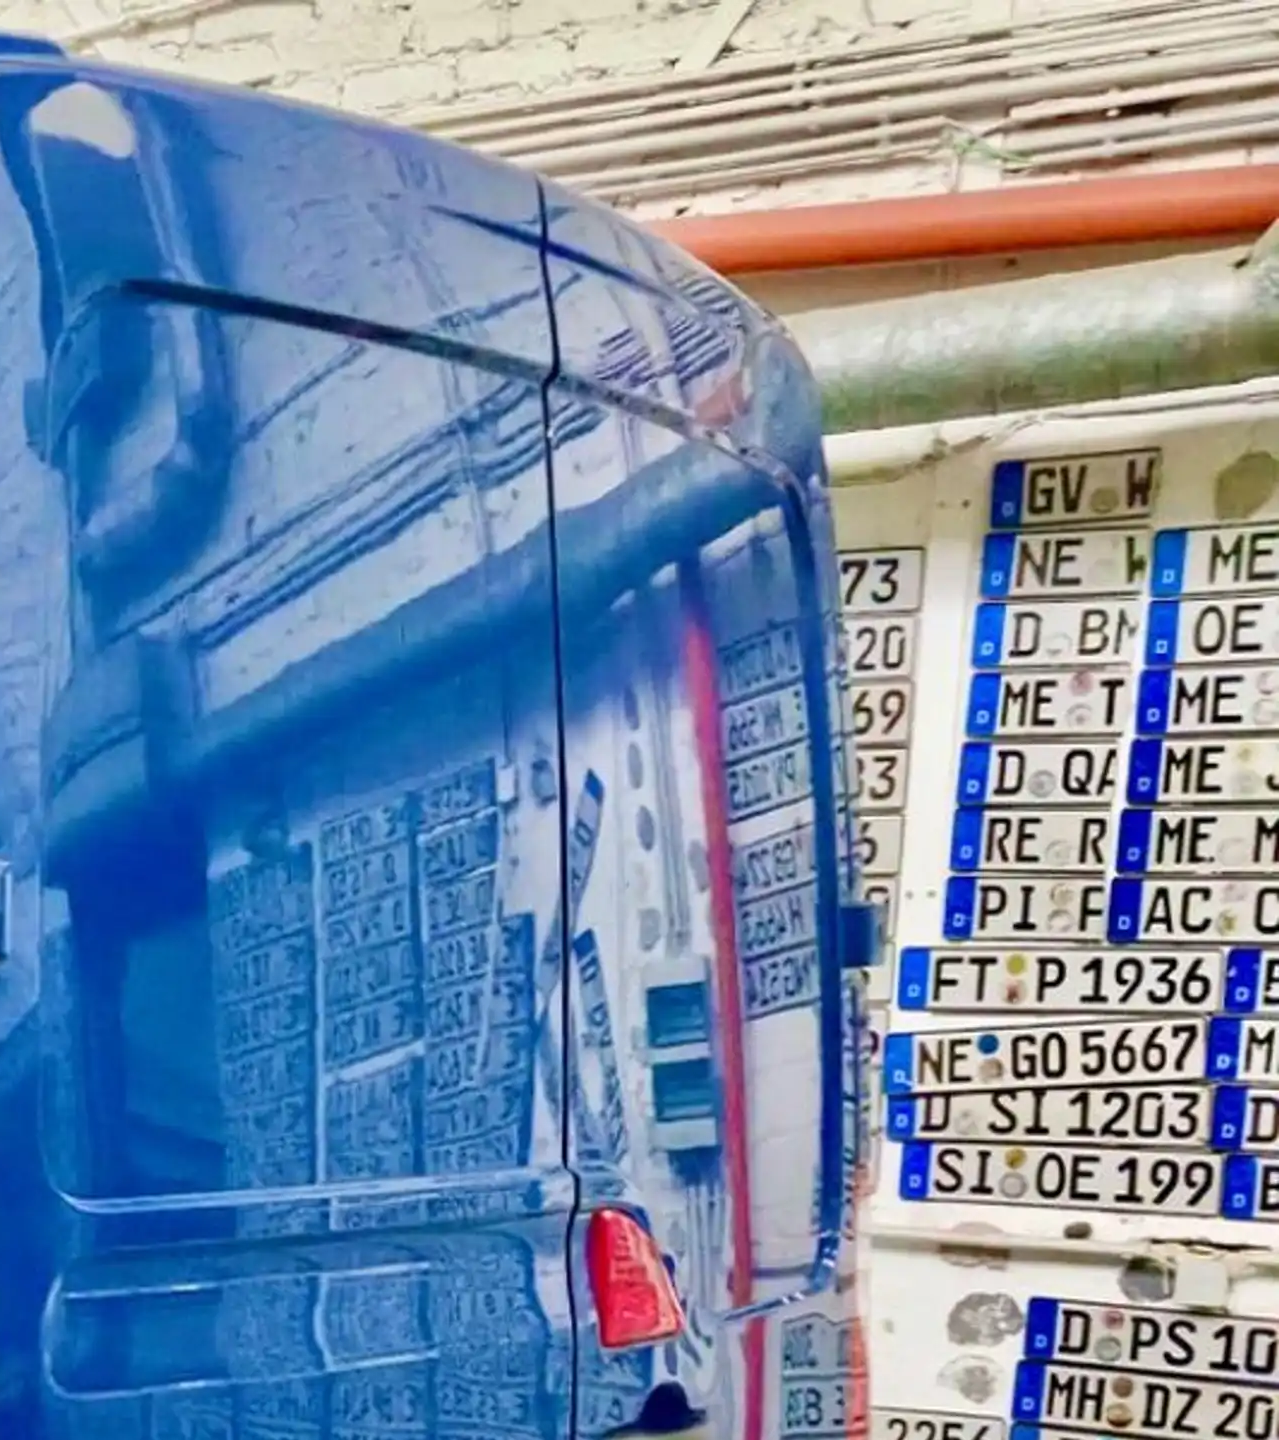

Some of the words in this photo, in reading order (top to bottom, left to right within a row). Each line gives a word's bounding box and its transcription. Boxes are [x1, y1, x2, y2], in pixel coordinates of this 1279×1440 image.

[1027, 464, 1088, 515] GV
[841, 557, 900, 606] 73
[991, 571, 1004, 587] D
[1015, 538, 1084, 588] NE
[1162, 569, 1176, 584] D
[1209, 532, 1279, 585] ME
[854, 625, 906, 671] 20
[981, 641, 995, 656] D
[1008, 611, 1044, 658] D
[1155, 640, 1168, 654] D
[1194, 603, 1264, 657] OE
[853, 688, 906, 736] 69
[976, 709, 990, 724] D
[1000, 679, 1059, 728] ME
[1099, 677, 1125, 727] T
[1146, 707, 1161, 723] D
[1173, 674, 1245, 726] ME
[966, 779, 980, 794] D
[993, 750, 1026, 796] D
[1137, 777, 1151, 792] D
[1162, 745, 1226, 794] ME
[959, 845, 974, 860] D
[985, 817, 1042, 863] RE
[1078, 817, 1108, 865] R
[1126, 847, 1140, 861] D
[1155, 816, 1218, 865] ME
[1253, 816, 1279, 865] M
[952, 913, 966, 928] D
[977, 885, 1037, 931] PI
[1078, 885, 1105, 932] F
[1117, 915, 1131, 930] D
[1144, 886, 1213, 934] AC
[907, 984, 921, 998] D
[933, 956, 998, 1002] FT
[1035, 957, 1067, 1003] P
[1079, 957, 1212, 1004] 1936
[1234, 986, 1250, 1003] D
[918, 1038, 973, 1085] NE
[1010, 1032, 1067, 1080] GO
[1080, 1024, 1198, 1077] 5667
[1216, 1053, 1231, 1070] D
[1244, 1026, 1279, 1075] M
[895, 1113, 909, 1128] D
[920, 1092, 952, 1132] D
[987, 1089, 1050, 1136] SI
[1066, 1091, 1200, 1138] 1203
[1221, 1122, 1236, 1139] D
[1246, 1096, 1279, 1143] D
[909, 1174, 922, 1188] D
[933, 1147, 994, 1194] SI
[1035, 1152, 1102, 1201] OE
[1113, 1156, 1215, 1207] 199
[1232, 1193, 1247, 1208] D
[1034, 1334, 1048, 1349] D
[1058, 1309, 1092, 1354] D
[1129, 1316, 1197, 1367] PS
[1209, 1324, 1278, 1375] 10
[1021, 1397, 1035, 1411] D
[1046, 1372, 1106, 1422] MH
[1141, 1383, 1202, 1434] DZ
[1213, 1391, 1279, 1440] 20
